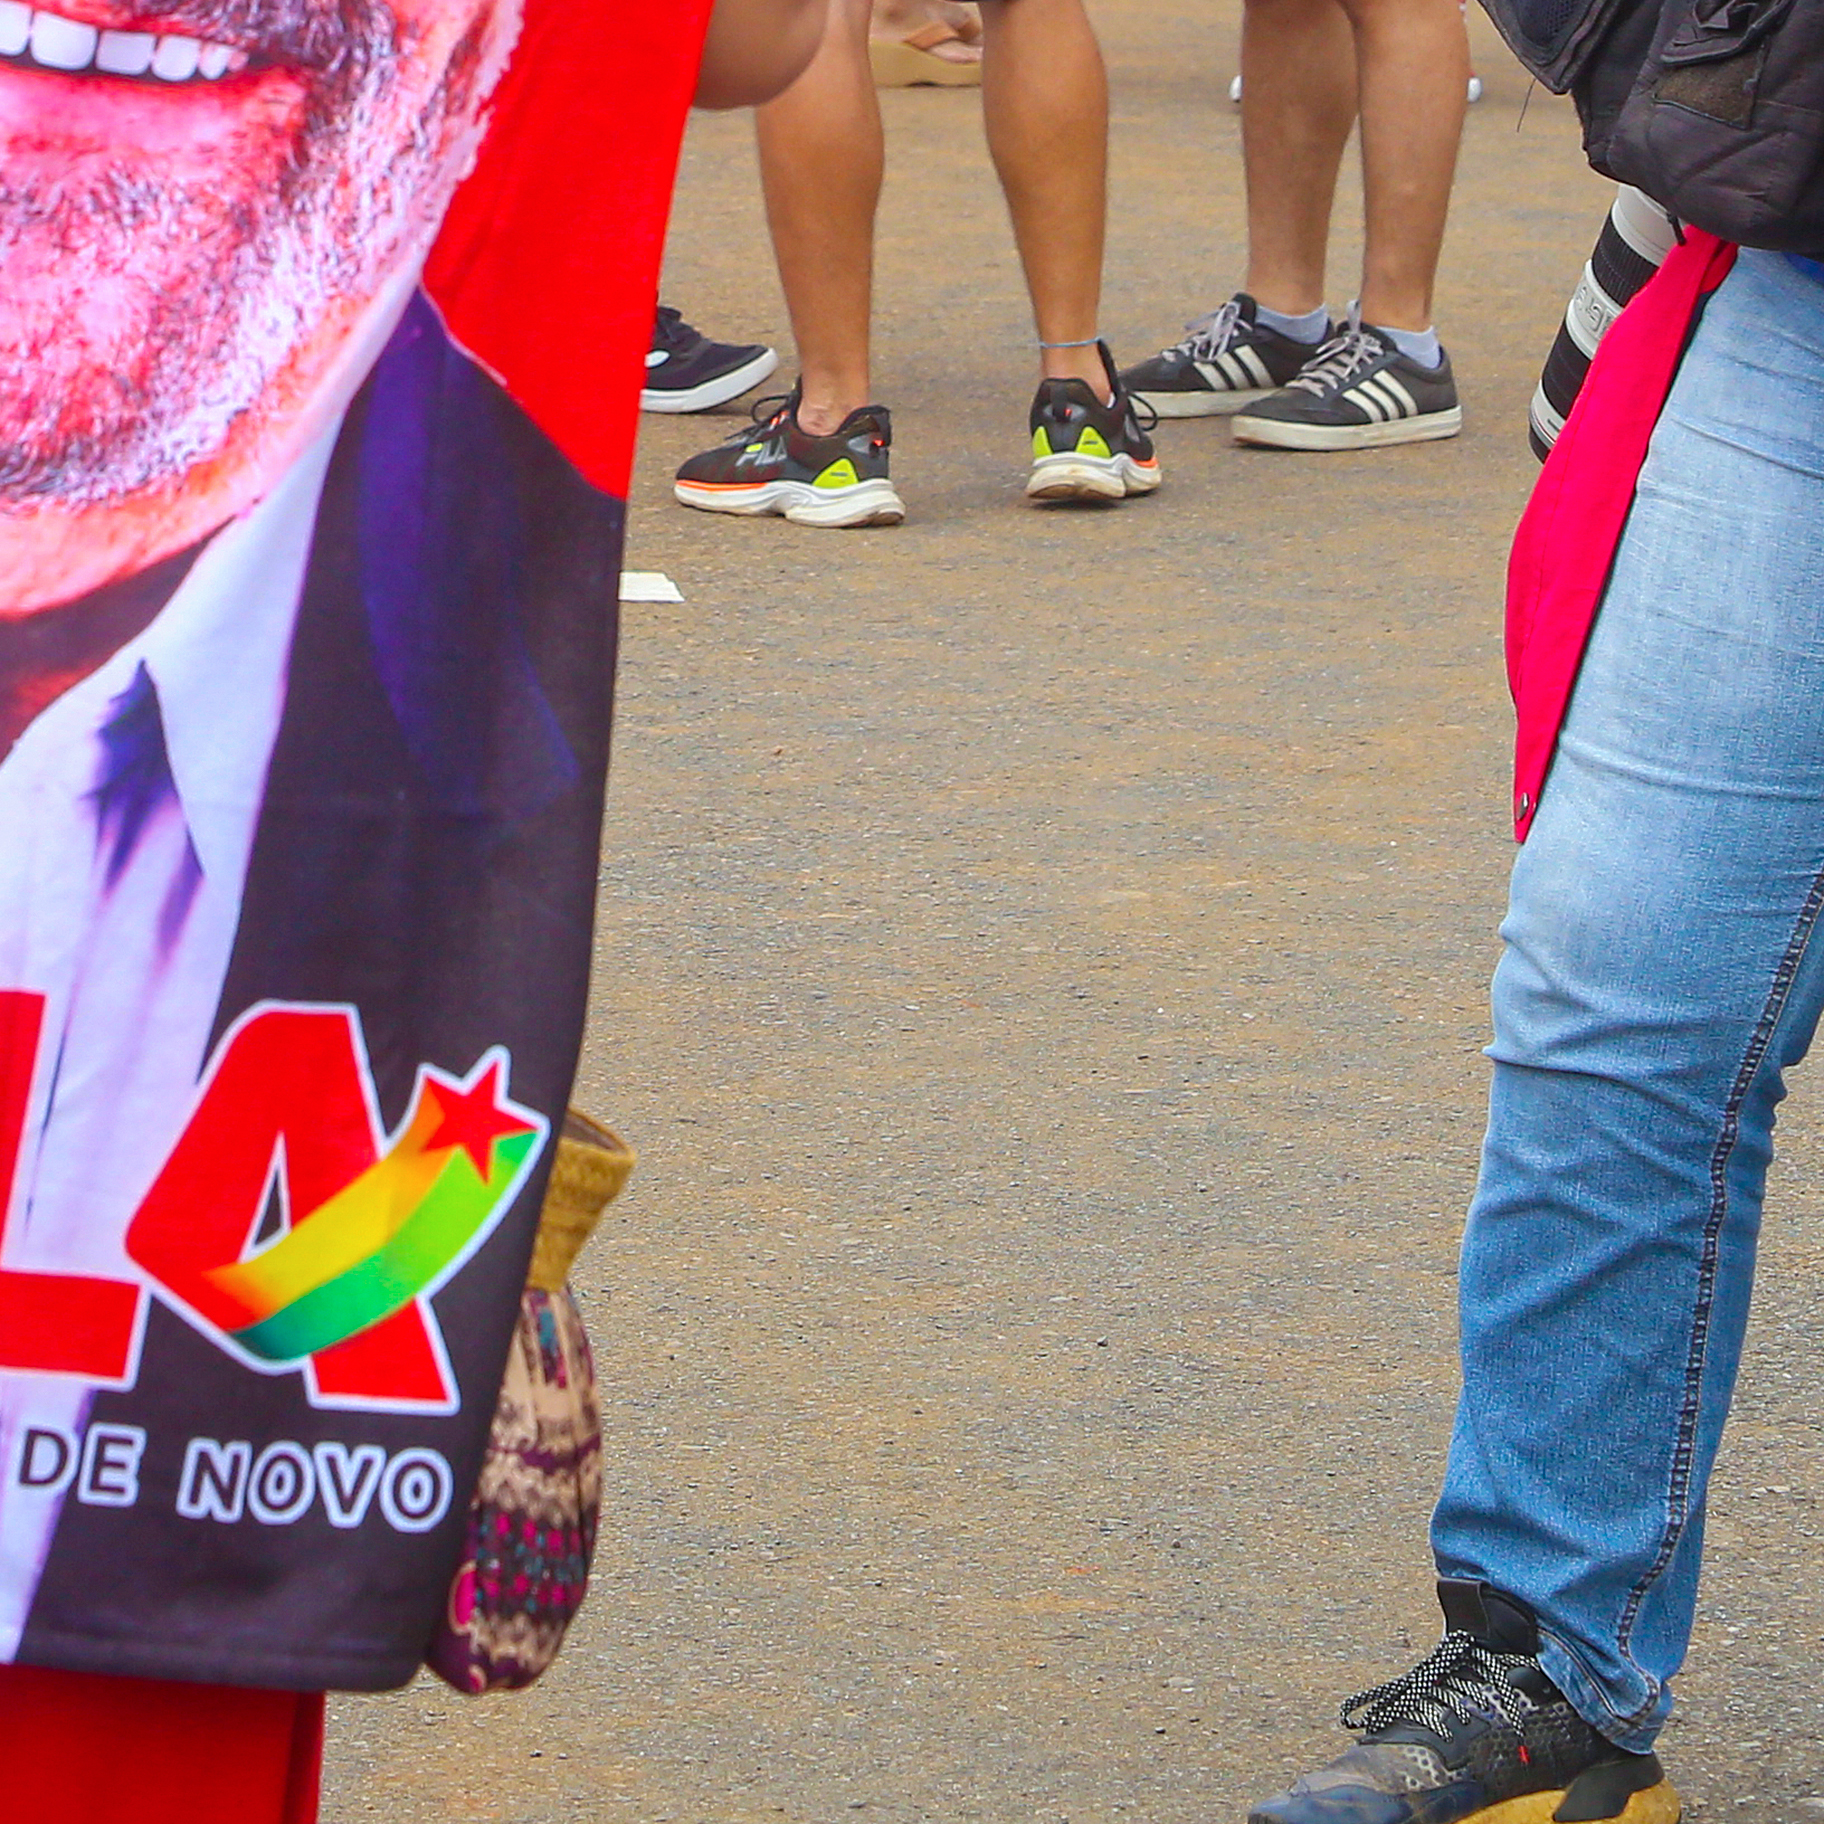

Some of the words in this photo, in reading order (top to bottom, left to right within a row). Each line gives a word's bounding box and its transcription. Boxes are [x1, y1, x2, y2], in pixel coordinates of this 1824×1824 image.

[735, 435, 788, 466] FILA
[18, 1428, 145, 1506] DE
[178, 1438, 454, 1533] NOVO
